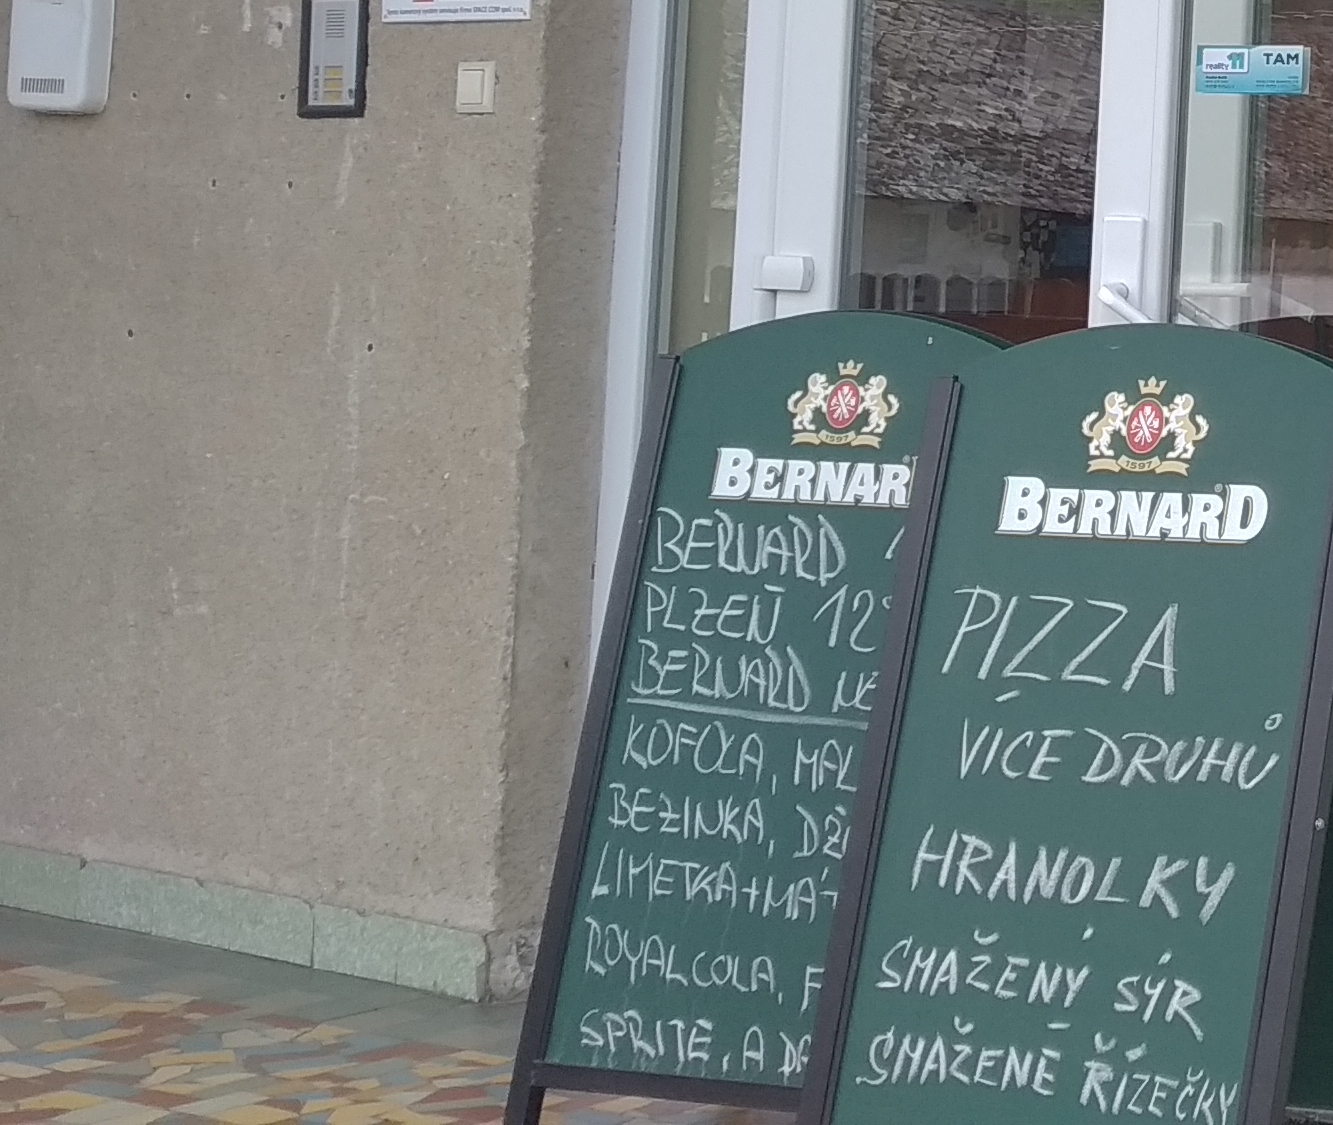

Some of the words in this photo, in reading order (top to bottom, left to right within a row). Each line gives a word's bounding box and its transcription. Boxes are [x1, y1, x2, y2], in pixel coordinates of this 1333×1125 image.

[1263, 52, 1300, 65] TAM
[825, 433, 849, 443] 1597
[1125, 459, 1153, 470] 1597
[708, 447, 918, 508] BERNAR
[994, 475, 1269, 545] BERNARD
[645, 580, 786, 644] PLZEŇ
[941, 585, 1179, 696] PIZZA
[960, 689, 1076, 780] VÍCE
[1080, 713, 1284, 791] DRUHŮ
[910, 823, 1238, 927] HRANOLKY
[874, 922, 1095, 1008] SMAŽENÝ
[1112, 948, 1205, 1043] SÝR
[855, 1015, 1071, 1097] SMAŽENÉ
[1078, 1030, 1240, 1125] ŘÍZEČKY
